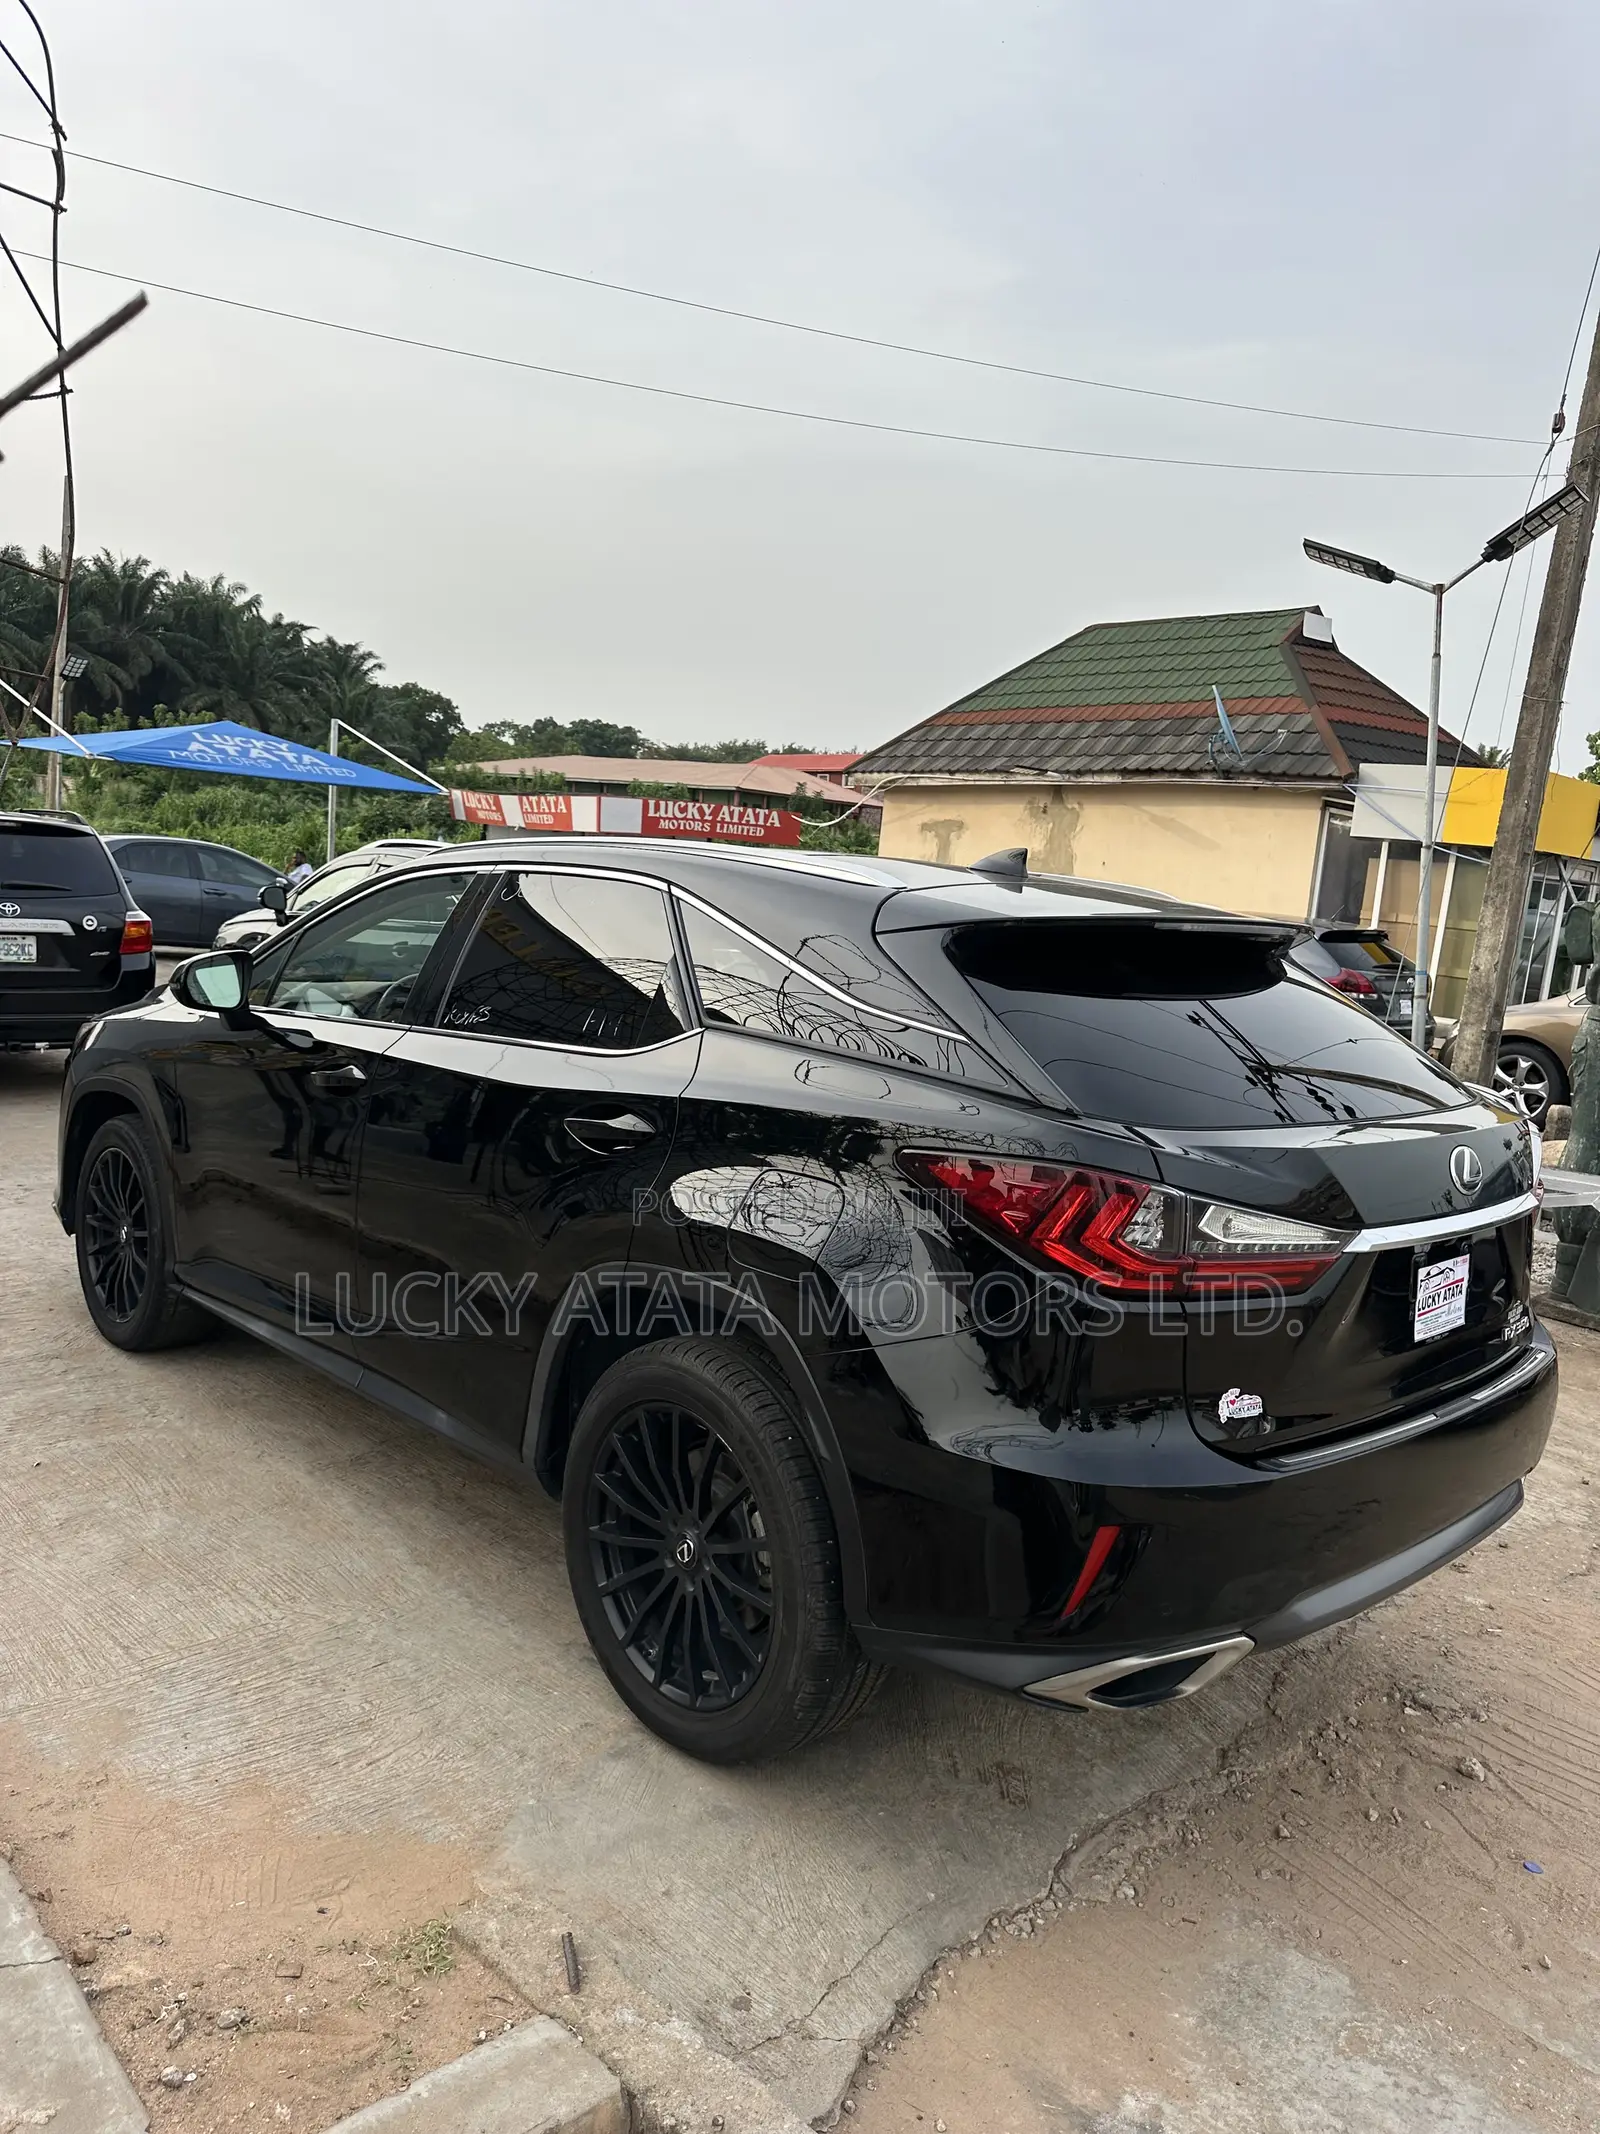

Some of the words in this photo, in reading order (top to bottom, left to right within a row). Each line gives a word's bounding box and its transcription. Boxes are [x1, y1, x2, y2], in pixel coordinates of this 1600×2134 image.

[193, 732, 290, 752] LUCKY
[169, 750, 273, 769] MOTORS
[281, 762, 357, 778] LIMITED
[187, 741, 329, 767] ATATA
[463, 791, 497, 810] LUCKY
[522, 796, 568, 813] ATATA
[475, 809, 503, 822] MOTORS
[523, 813, 554, 825] LIMITED
[647, 800, 715, 820] LUCKY
[716, 805, 781, 827] ATATA
[658, 819, 711, 832] MOTORS
[716, 822, 764, 837] LIMITED
[1417, 1291, 1443, 1312] LUCKY
[1443, 1283, 1463, 1303] ATATA
[1229, 1406, 1246, 1415] LUCKY
[1246, 1404, 1262, 1412] ATATA
